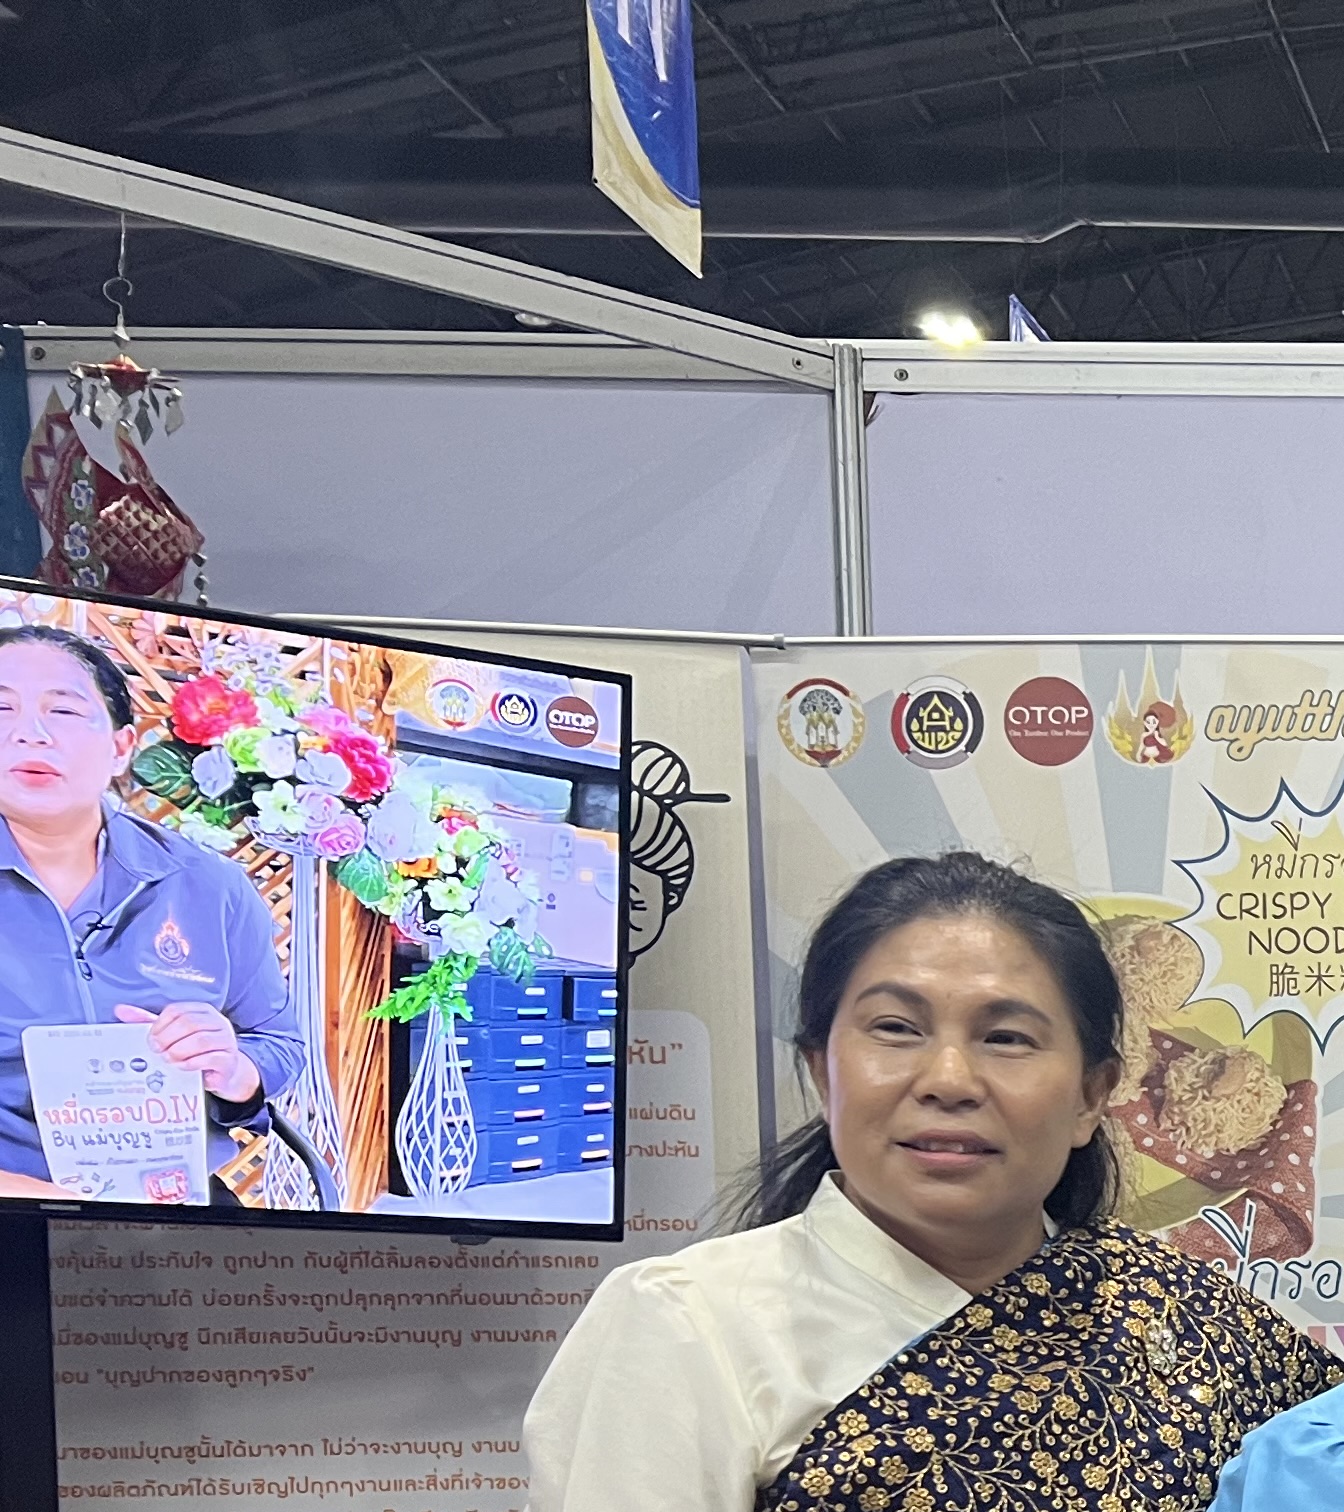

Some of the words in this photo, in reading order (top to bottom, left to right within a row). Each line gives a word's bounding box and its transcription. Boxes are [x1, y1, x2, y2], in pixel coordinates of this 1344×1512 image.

[549, 708, 596, 728] OTOP
[1008, 706, 1089, 725] OTOP
[1216, 891, 1333, 921] CRISPY
